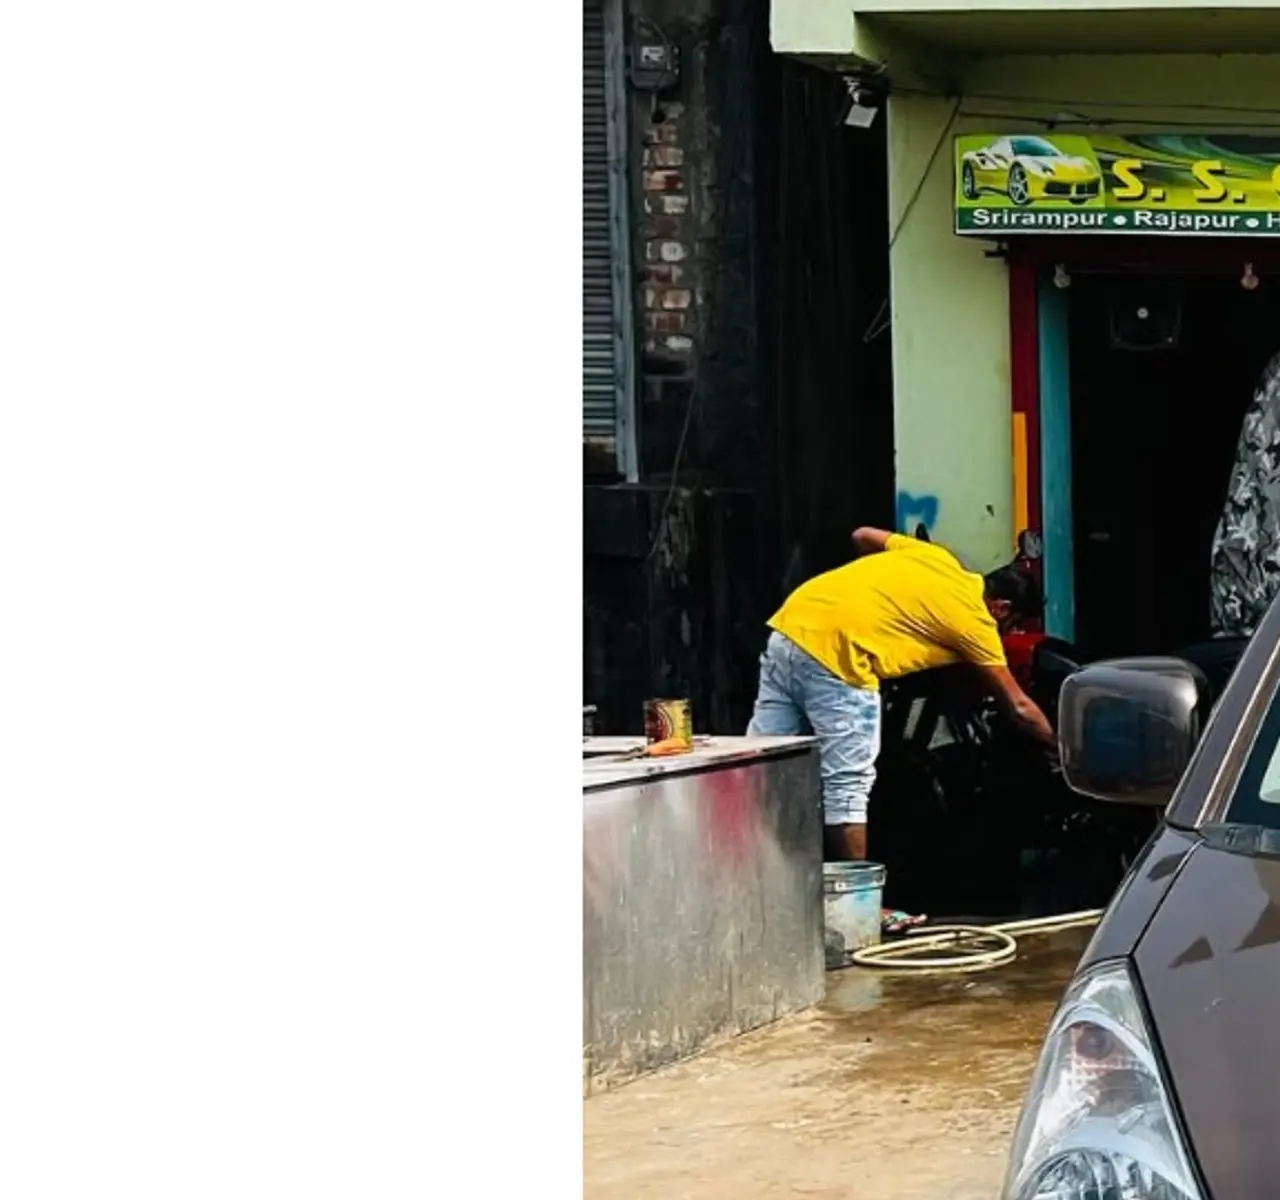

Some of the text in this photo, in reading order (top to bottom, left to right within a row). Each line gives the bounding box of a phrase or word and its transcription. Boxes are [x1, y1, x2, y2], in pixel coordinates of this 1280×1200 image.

[1111, 158, 1166, 203] S.
[1192, 159, 1247, 204] S.
[972, 208, 1108, 229] Srirampur
[1133, 210, 1240, 230] Rajapur
